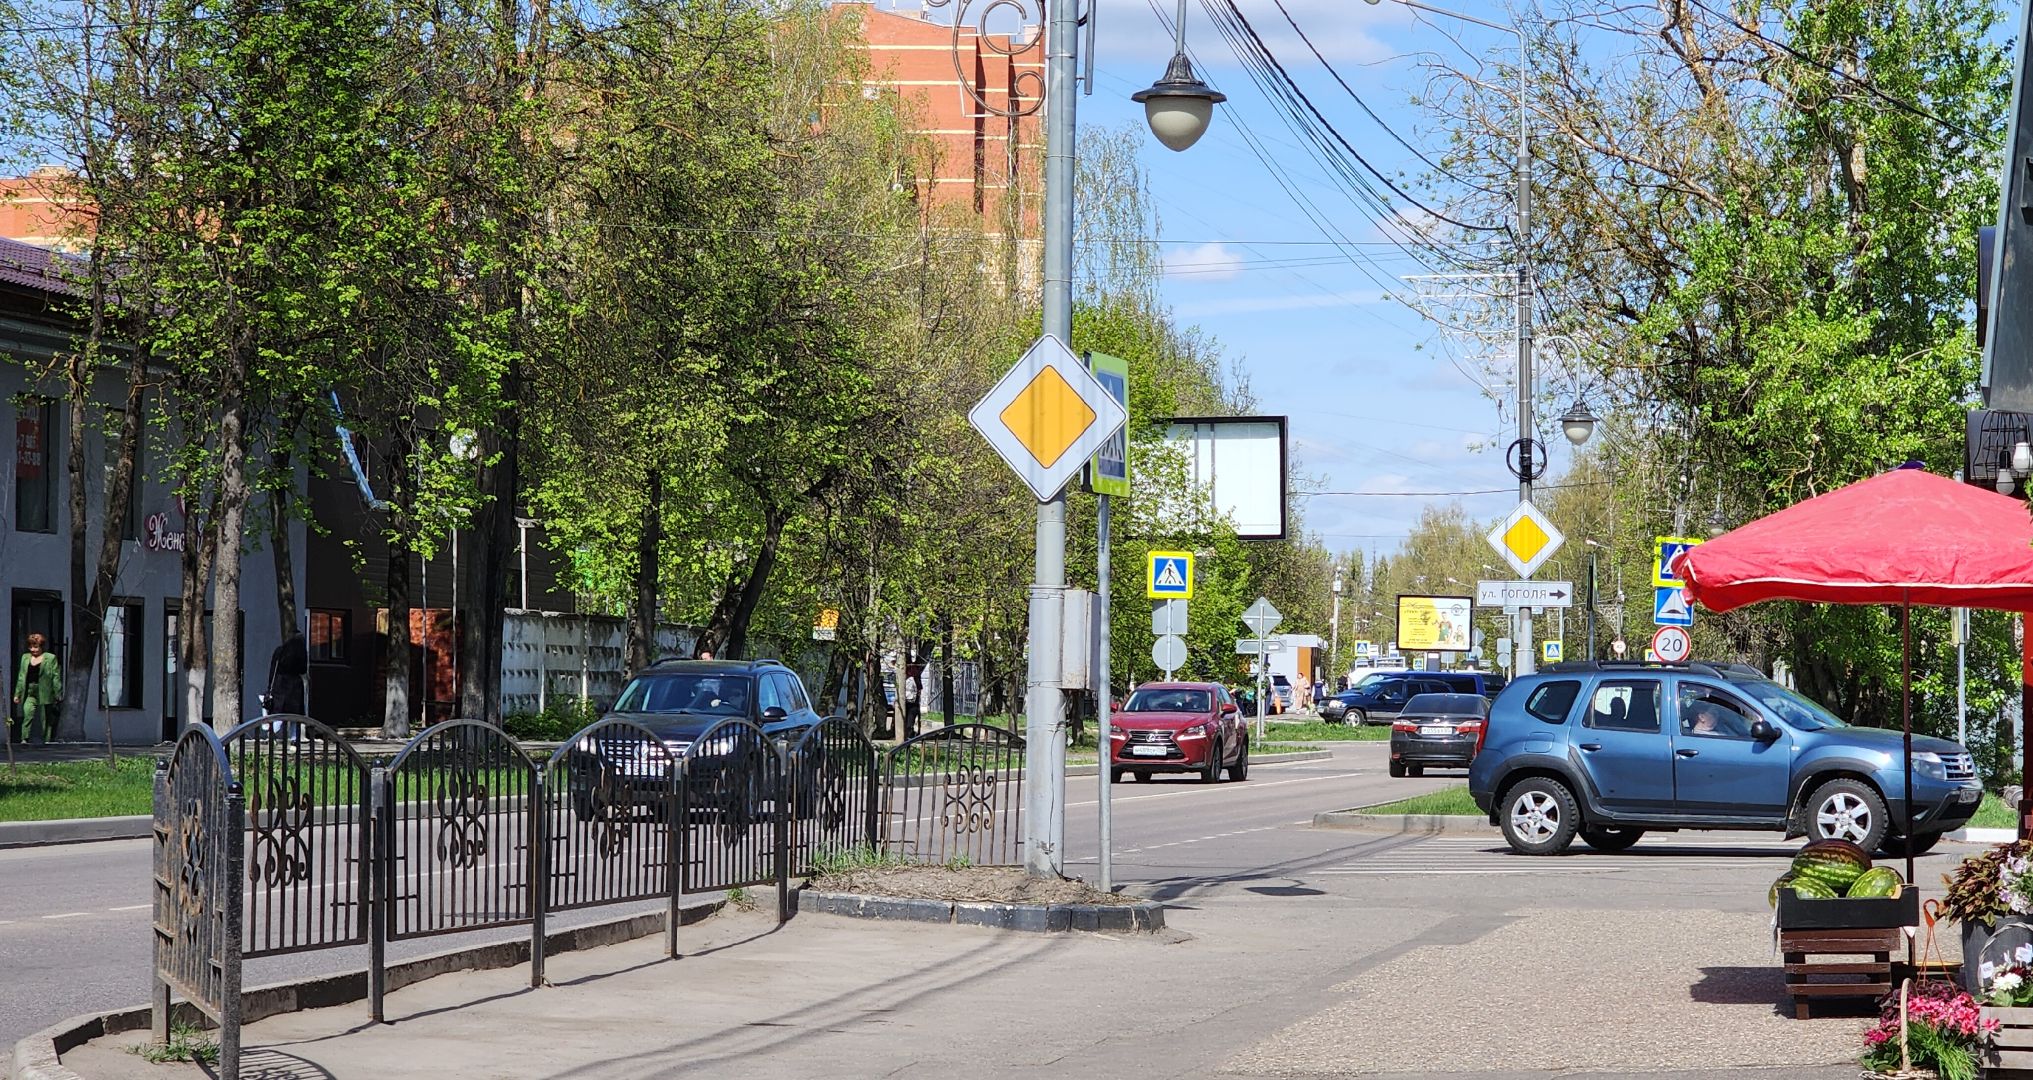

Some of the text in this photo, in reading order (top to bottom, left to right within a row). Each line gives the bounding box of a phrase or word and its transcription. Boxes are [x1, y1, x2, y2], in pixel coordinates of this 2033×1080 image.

[1481, 588, 1547, 600] ул. ГОГОЛЯ
[1661, 637, 1682, 653] 20
